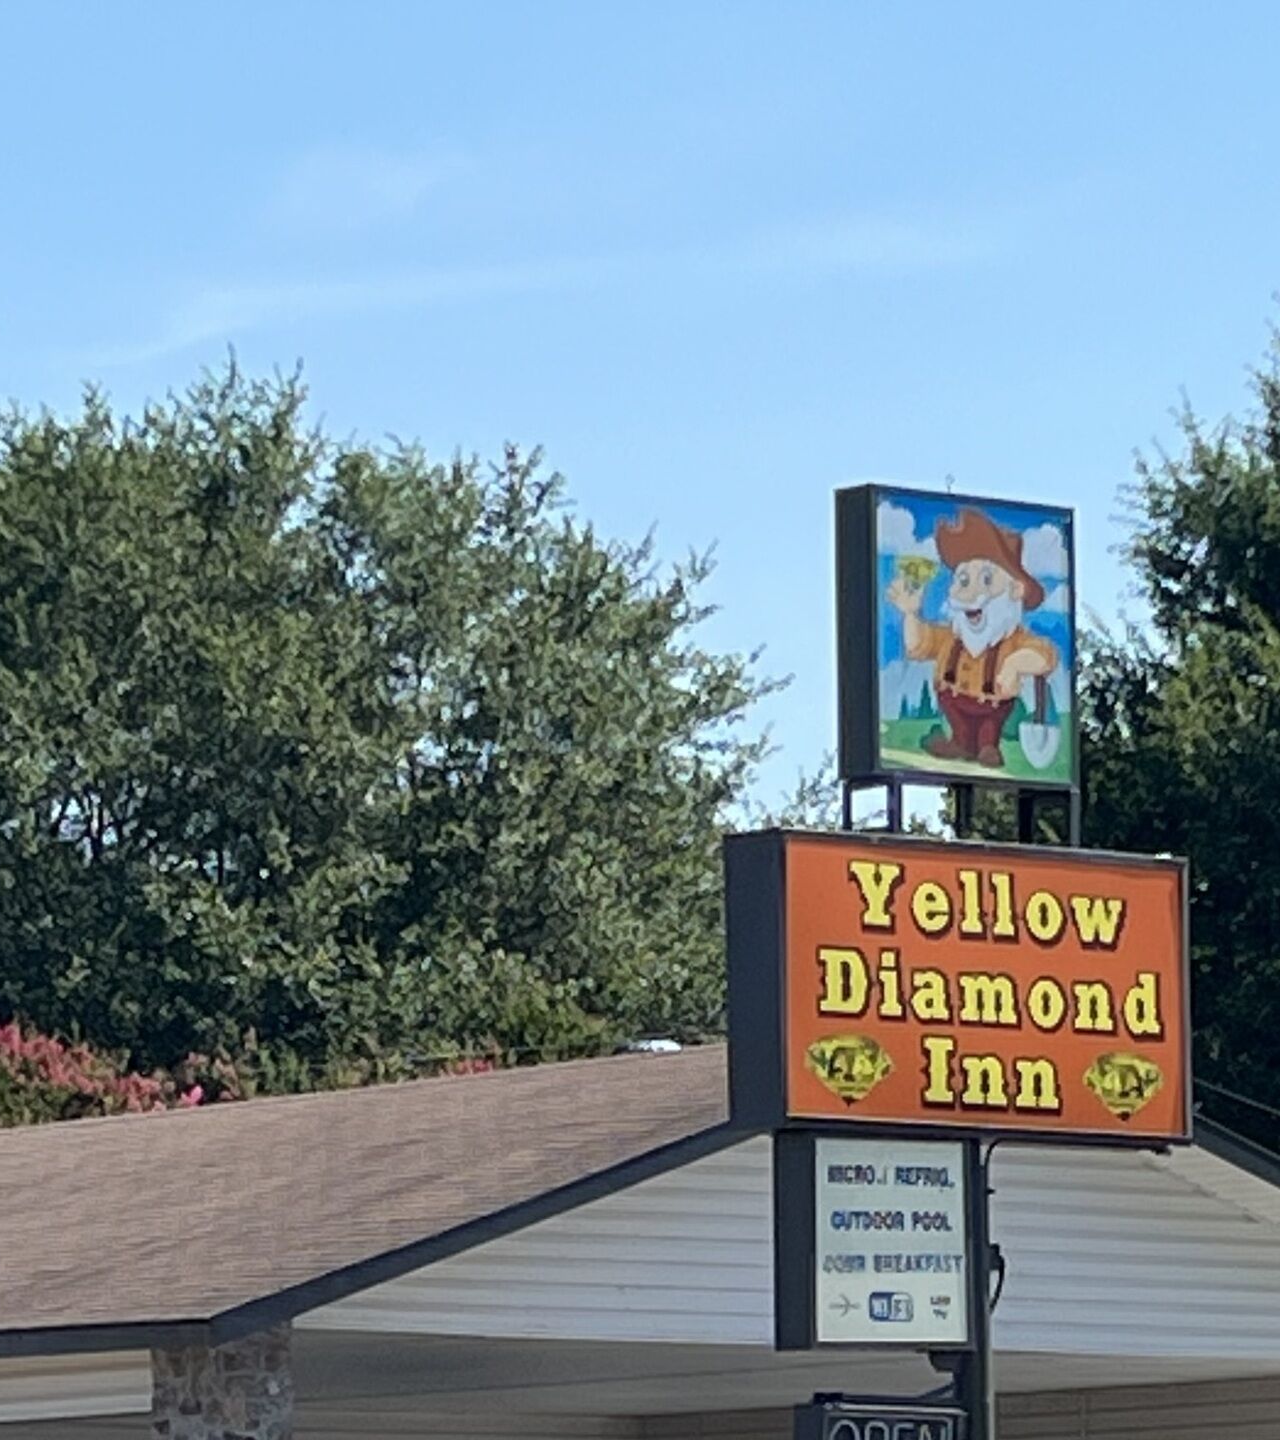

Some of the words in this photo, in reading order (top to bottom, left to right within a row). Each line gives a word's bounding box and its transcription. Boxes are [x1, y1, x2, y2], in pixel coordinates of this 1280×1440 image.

[848, 859, 1124, 948] Yellow
[817, 946, 1164, 1039] Diamond
[921, 1035, 1062, 1112] Inn
[831, 1210, 905, 1231] OUTDOOR
[911, 1211, 953, 1231] POOL
[873, 1254, 962, 1273] BREAKFAST
